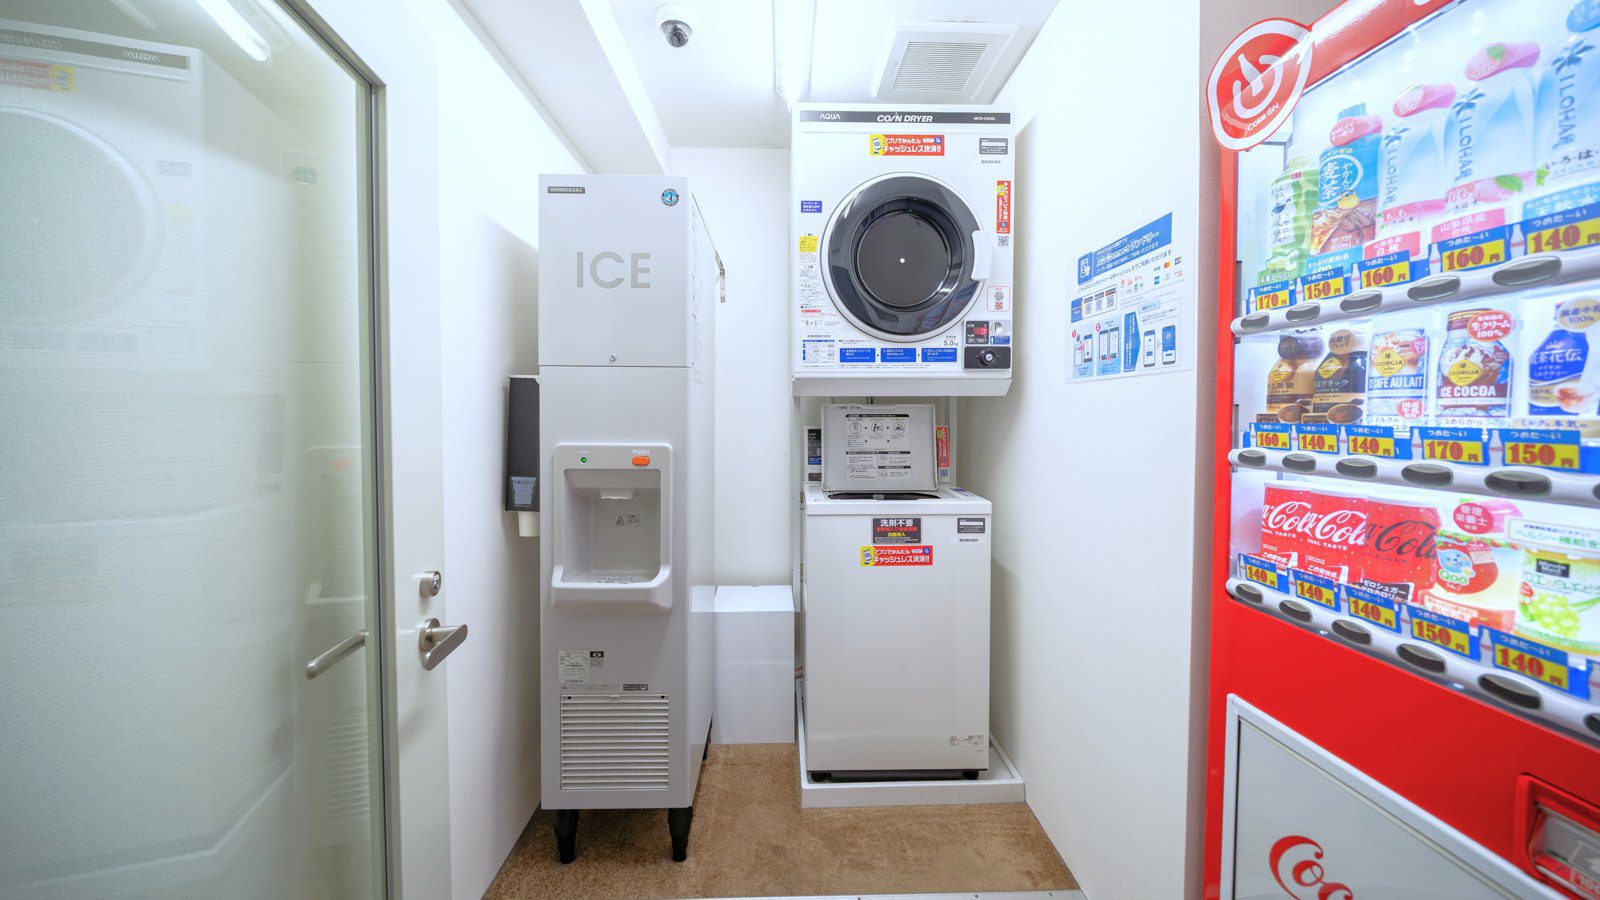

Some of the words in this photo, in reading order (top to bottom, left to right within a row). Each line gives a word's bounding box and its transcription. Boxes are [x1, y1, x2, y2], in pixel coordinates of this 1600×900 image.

[877, 112, 902, 122] COIN
[1322, 161, 1341, 199] 麦茶
[577, 251, 651, 289] ICE
[1471, 321, 1511, 331] 生クリーム
[1476, 330, 1504, 338] 100%
[1389, 377, 1403, 388] AU
[1404, 376, 1423, 387] LAIT
[1440, 387, 1452, 397] ICE
[1454, 385, 1496, 397] COCOA
[880, 518, 914, 527] 洗剤不要
[1275, 531, 1297, 539] TASTE
[1323, 542, 1348, 550] TASTE
[1439, 569, 1468, 584] Qoo
[1363, 579, 1407, 595] ゼロシュガー
